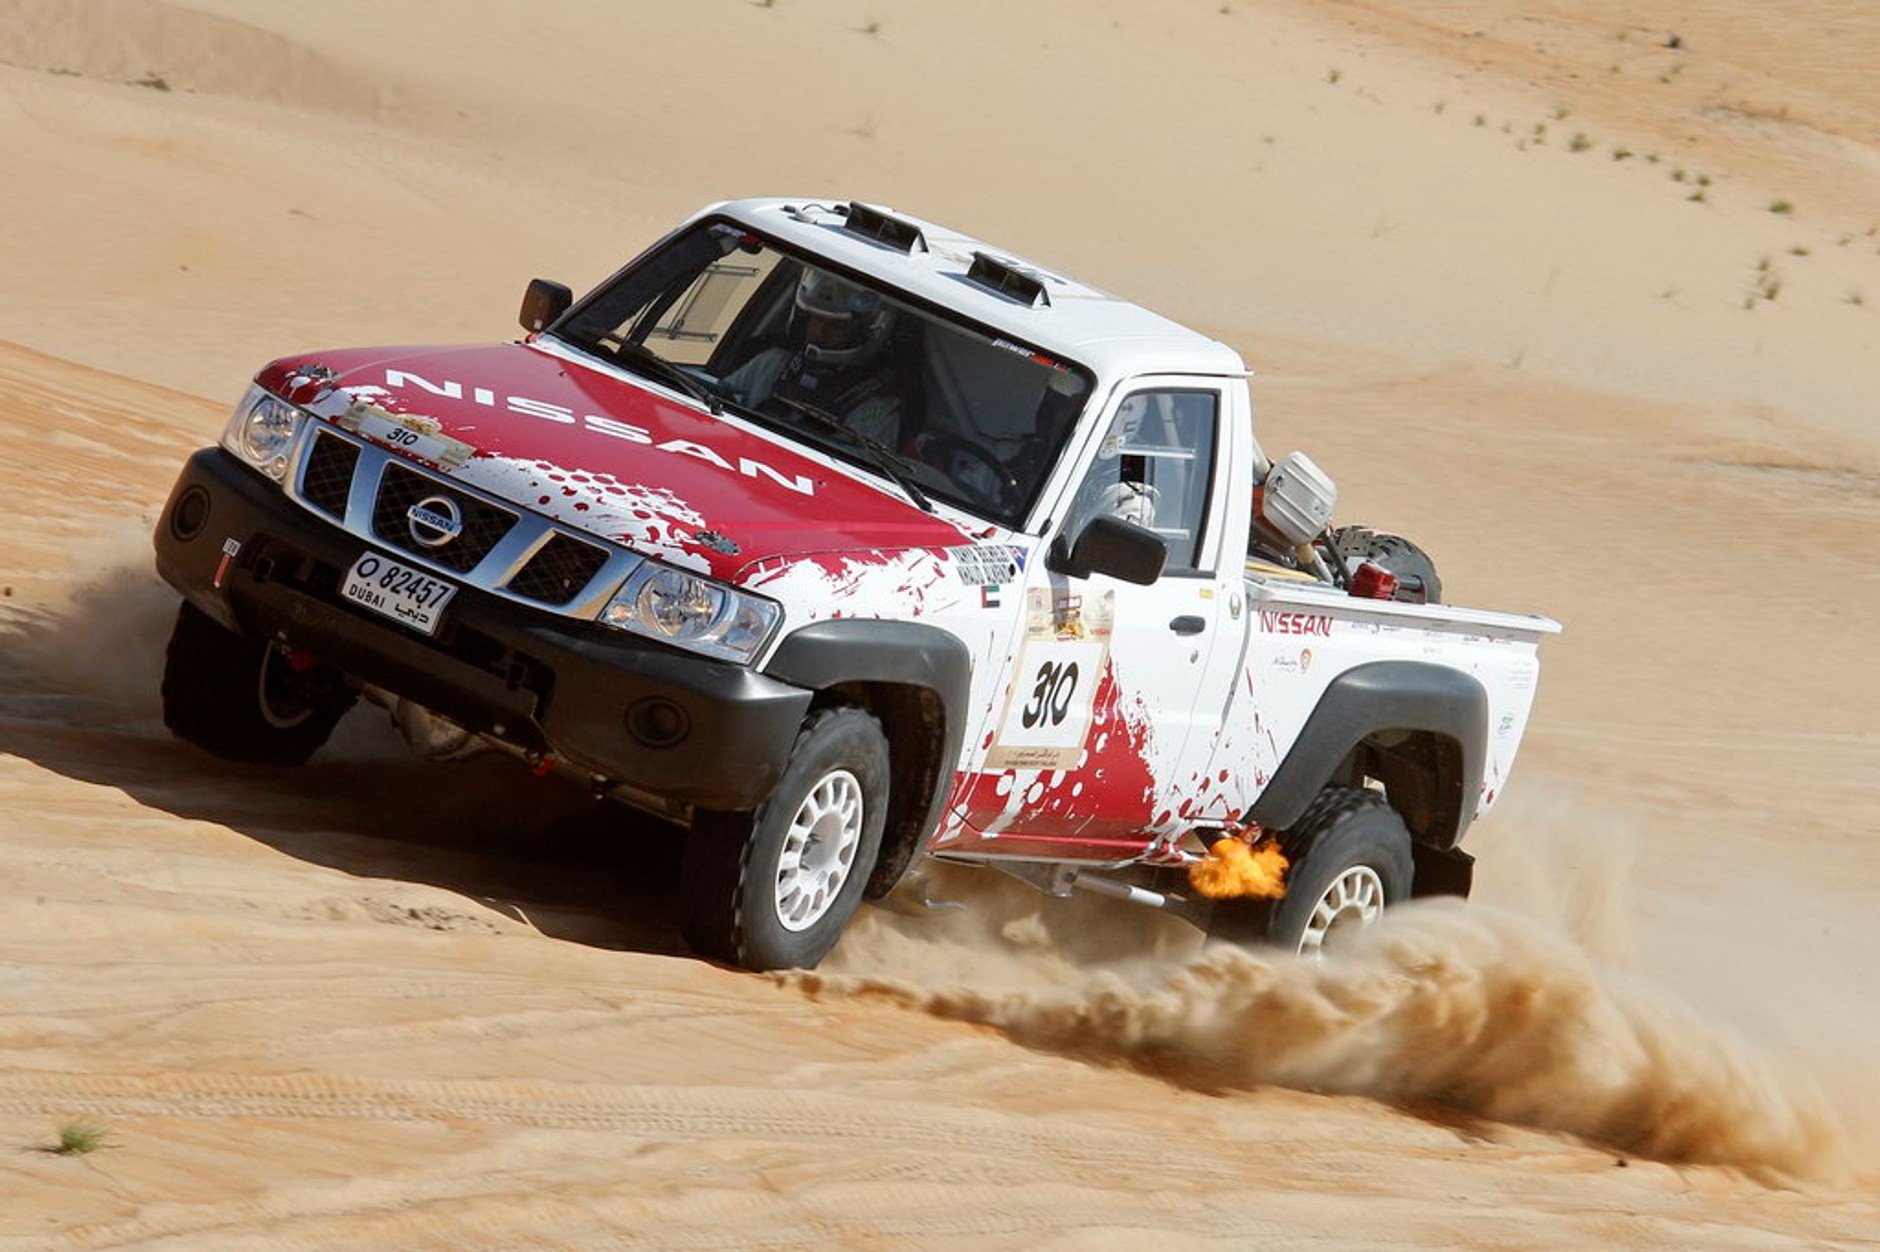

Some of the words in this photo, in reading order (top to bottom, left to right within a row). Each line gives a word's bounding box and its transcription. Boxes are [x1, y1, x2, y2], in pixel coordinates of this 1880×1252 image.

[385, 369, 815, 496] NISSAN
[387, 427, 418, 446] 310
[411, 507, 456, 532] NISSAN
[349, 584, 385, 608] DUBAI
[357, 558, 380, 578] O
[380, 566, 449, 609] 82457
[1258, 608, 1334, 637] NISSAN
[1022, 660, 1079, 729] 310
